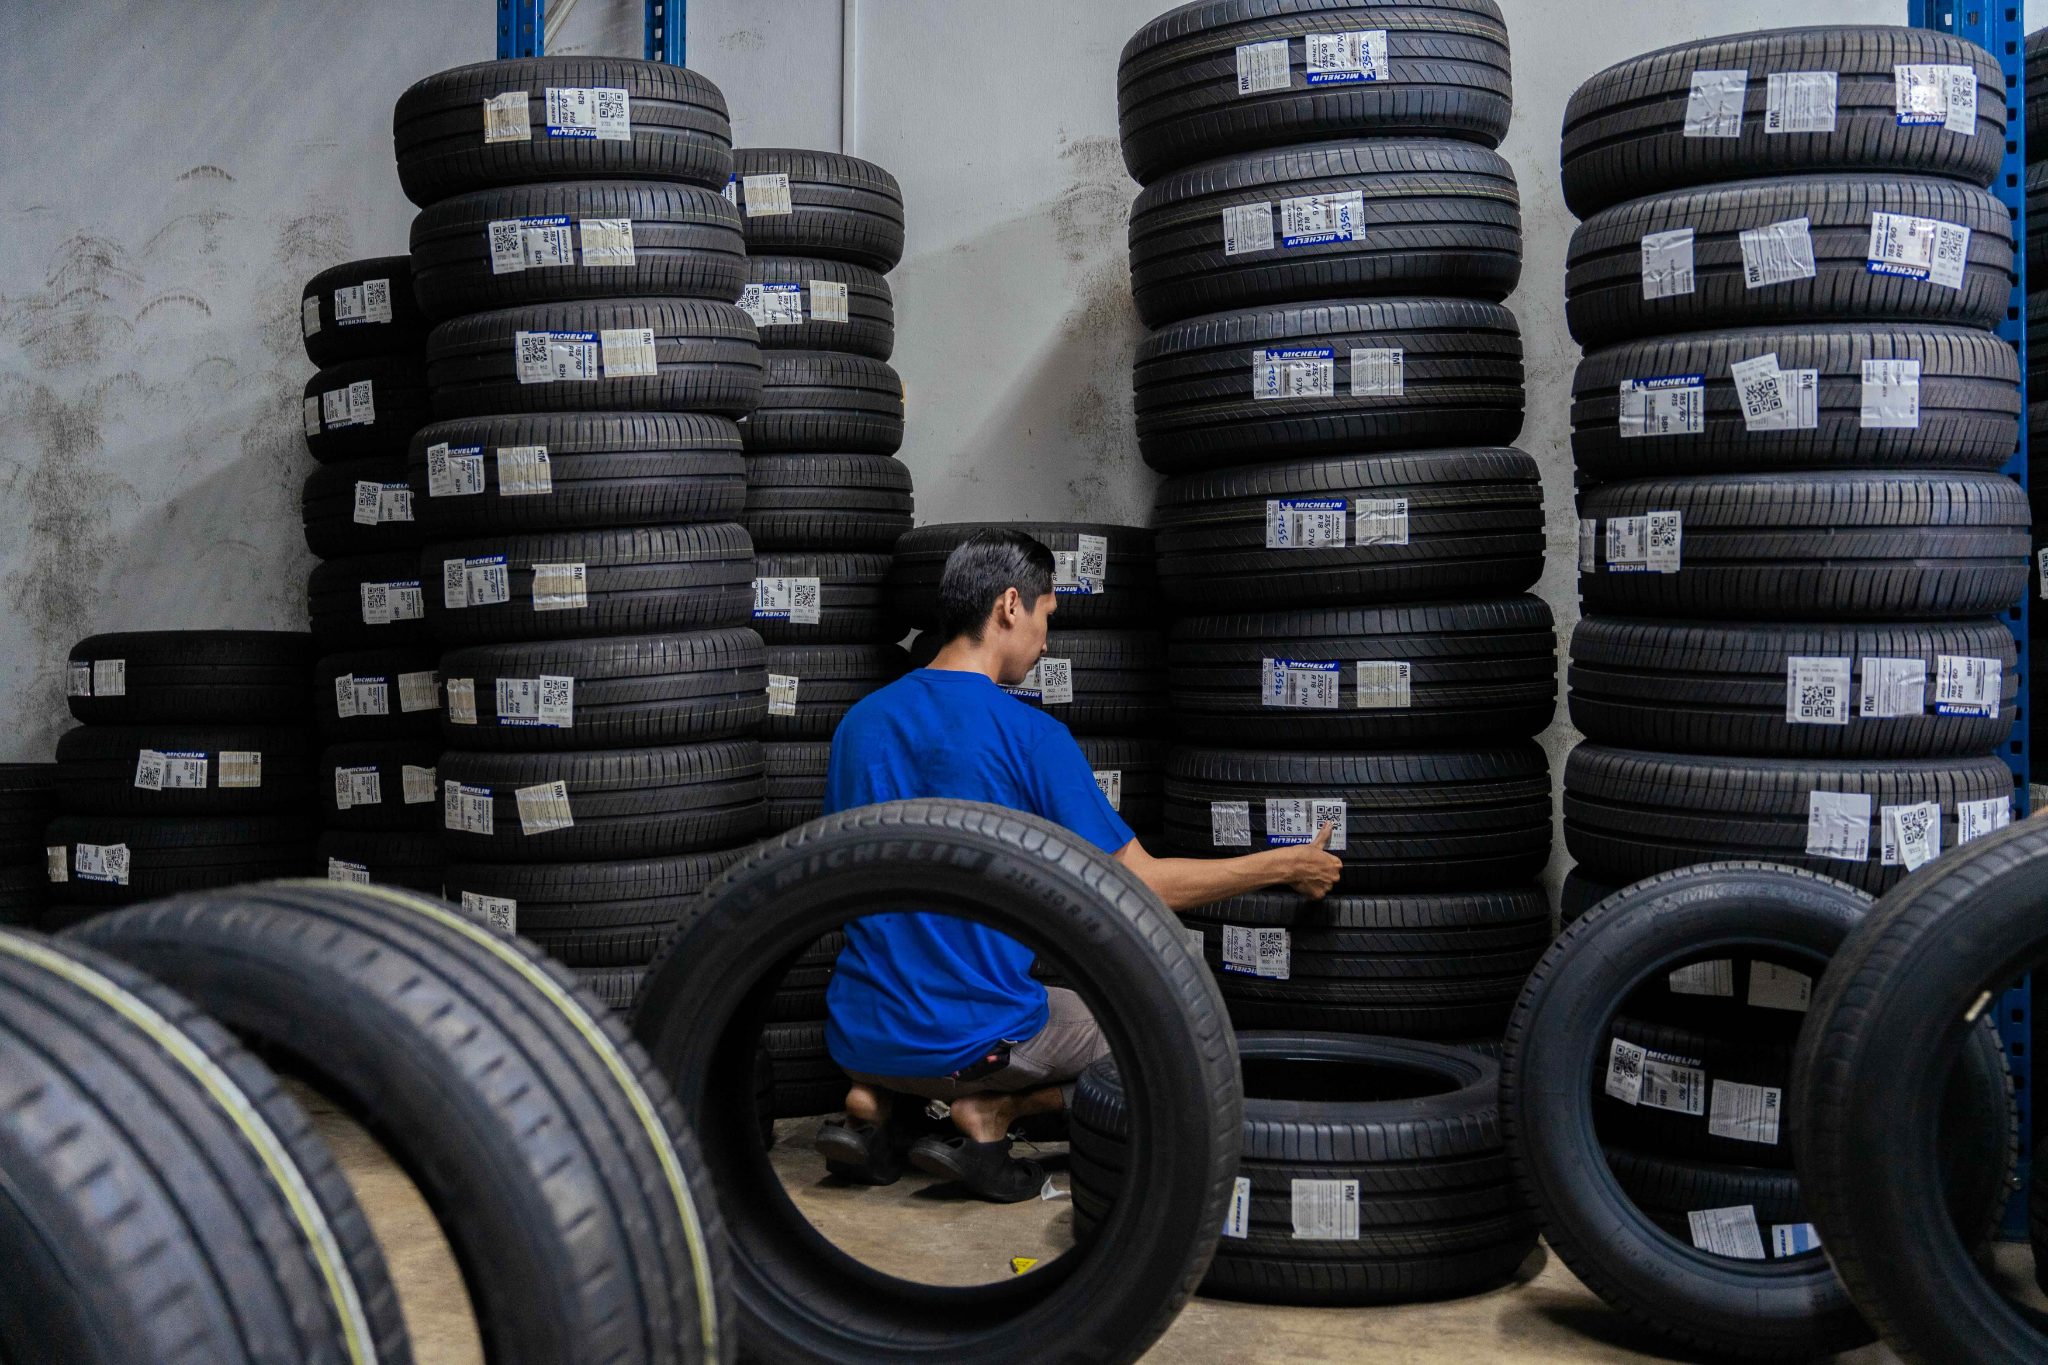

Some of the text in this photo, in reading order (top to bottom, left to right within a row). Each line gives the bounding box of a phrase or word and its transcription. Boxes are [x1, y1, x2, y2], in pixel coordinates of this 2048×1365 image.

[1337, 34, 1345, 53] 97W
[1241, 76, 1250, 91] RM
[1311, 72, 1359, 82] MICHELIN
[1770, 110, 1780, 129] RM
[779, 176, 786, 188] RM
[1312, 196, 1320, 216] 97W
[520, 218, 567, 228] MICHELIN
[1296, 207, 1304, 232] 235/50
[1228, 238, 1236, 252] RM
[1287, 233, 1335, 246] MICHELIN
[1749, 266, 1761, 283] RM
[1871, 263, 1928, 277] MICHELIN
[840, 286, 846, 297] RM
[643, 332, 651, 346] RM
[1281, 349, 1330, 359] MICHELIN
[1392, 352, 1400, 366] RM
[1295, 377, 1303, 396] 97W
[1647, 377, 1700, 388] MICHELIN
[1802, 373, 1814, 389] RM
[537, 449, 546, 464] RM
[1295, 501, 1343, 509] MICHELIN
[1397, 502, 1405, 515] RM
[466, 556, 504, 566] MICHELIN
[574, 566, 583, 580] RM
[1289, 661, 1336, 669] MICHELIN
[1399, 664, 1407, 679] RM
[1275, 671, 1285, 696] 3522
[1301, 687, 1309, 706] 97W
[1864, 695, 1875, 712] RM
[1939, 705, 1981, 715] MICHELIN
[166, 751, 205, 760] MICHELIN
[1112, 772, 1119, 785] RM
[554, 784, 564, 798] RM
[1885, 843, 1896, 861] RM
[775, 842, 983, 888] MICHELIN
[1647, 1050, 1702, 1066] MICHELIN
[1765, 1091, 1777, 1109] RM
[1345, 1185, 1355, 1201] RM
